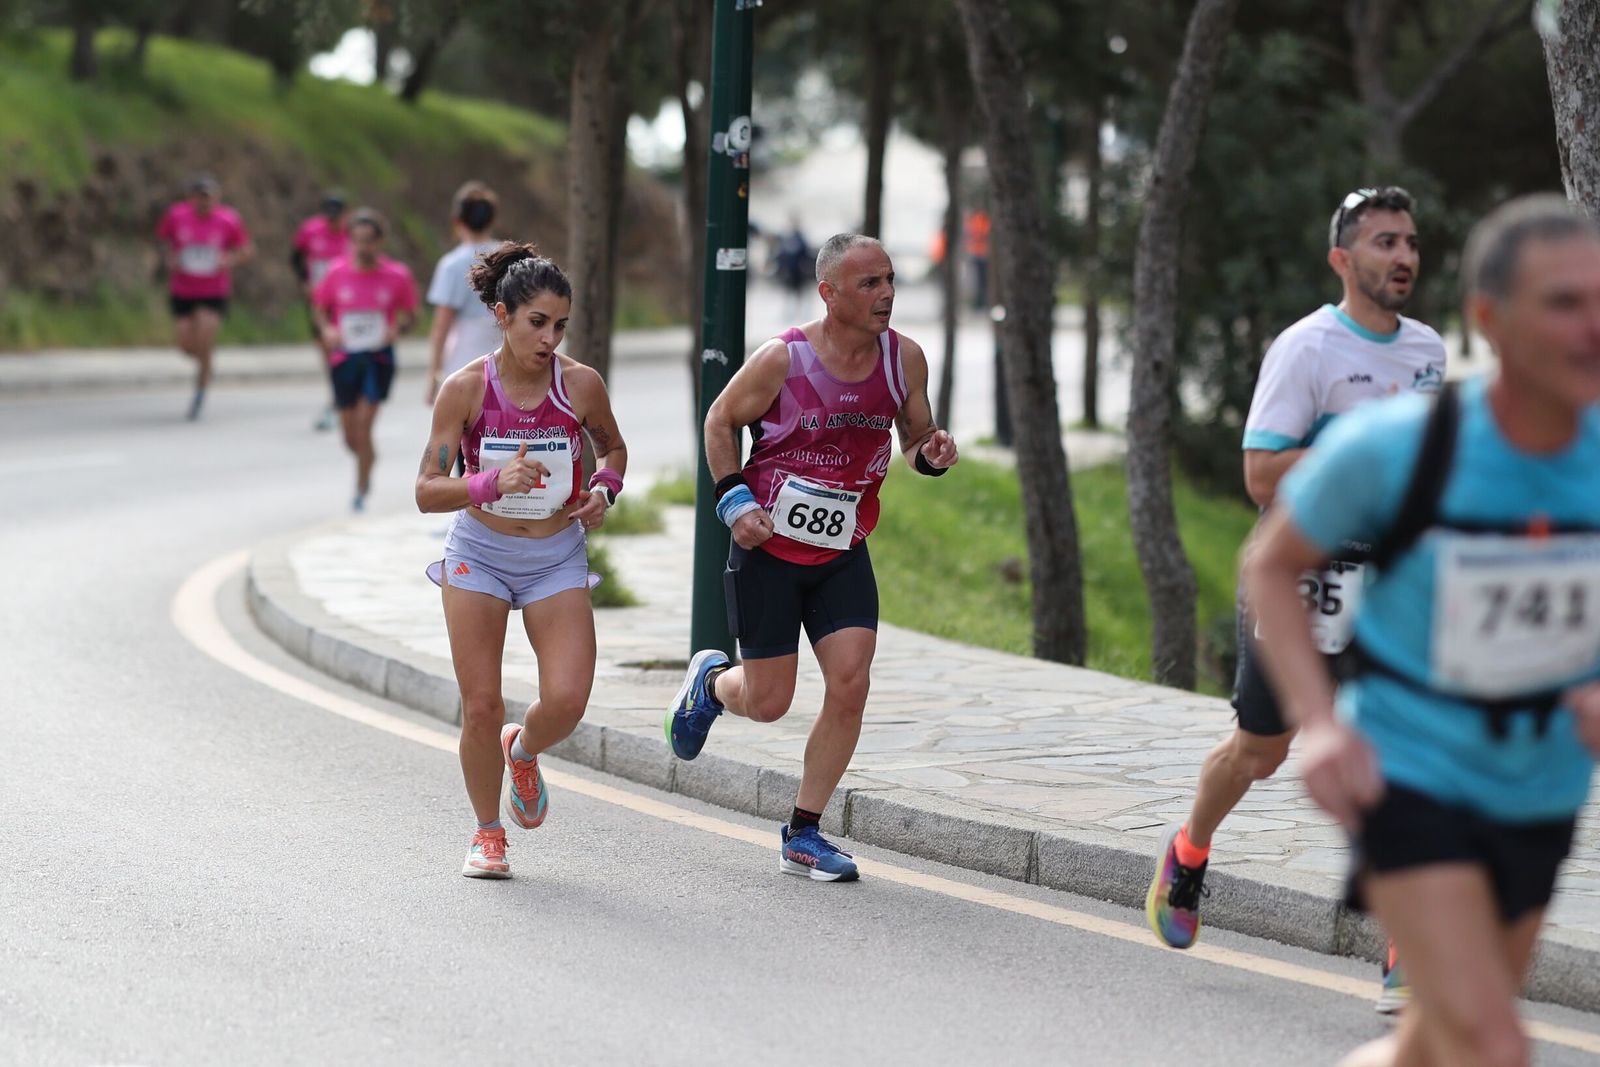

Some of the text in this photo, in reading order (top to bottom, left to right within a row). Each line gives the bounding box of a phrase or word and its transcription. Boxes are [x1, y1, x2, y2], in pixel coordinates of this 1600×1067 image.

[840, 391, 860, 403] vive
[801, 411, 893, 430] LA ANTORCHA
[484, 425, 568, 440] LA ANTORCHA
[787, 502, 846, 537] 688
[1475, 580, 1588, 639] 741
